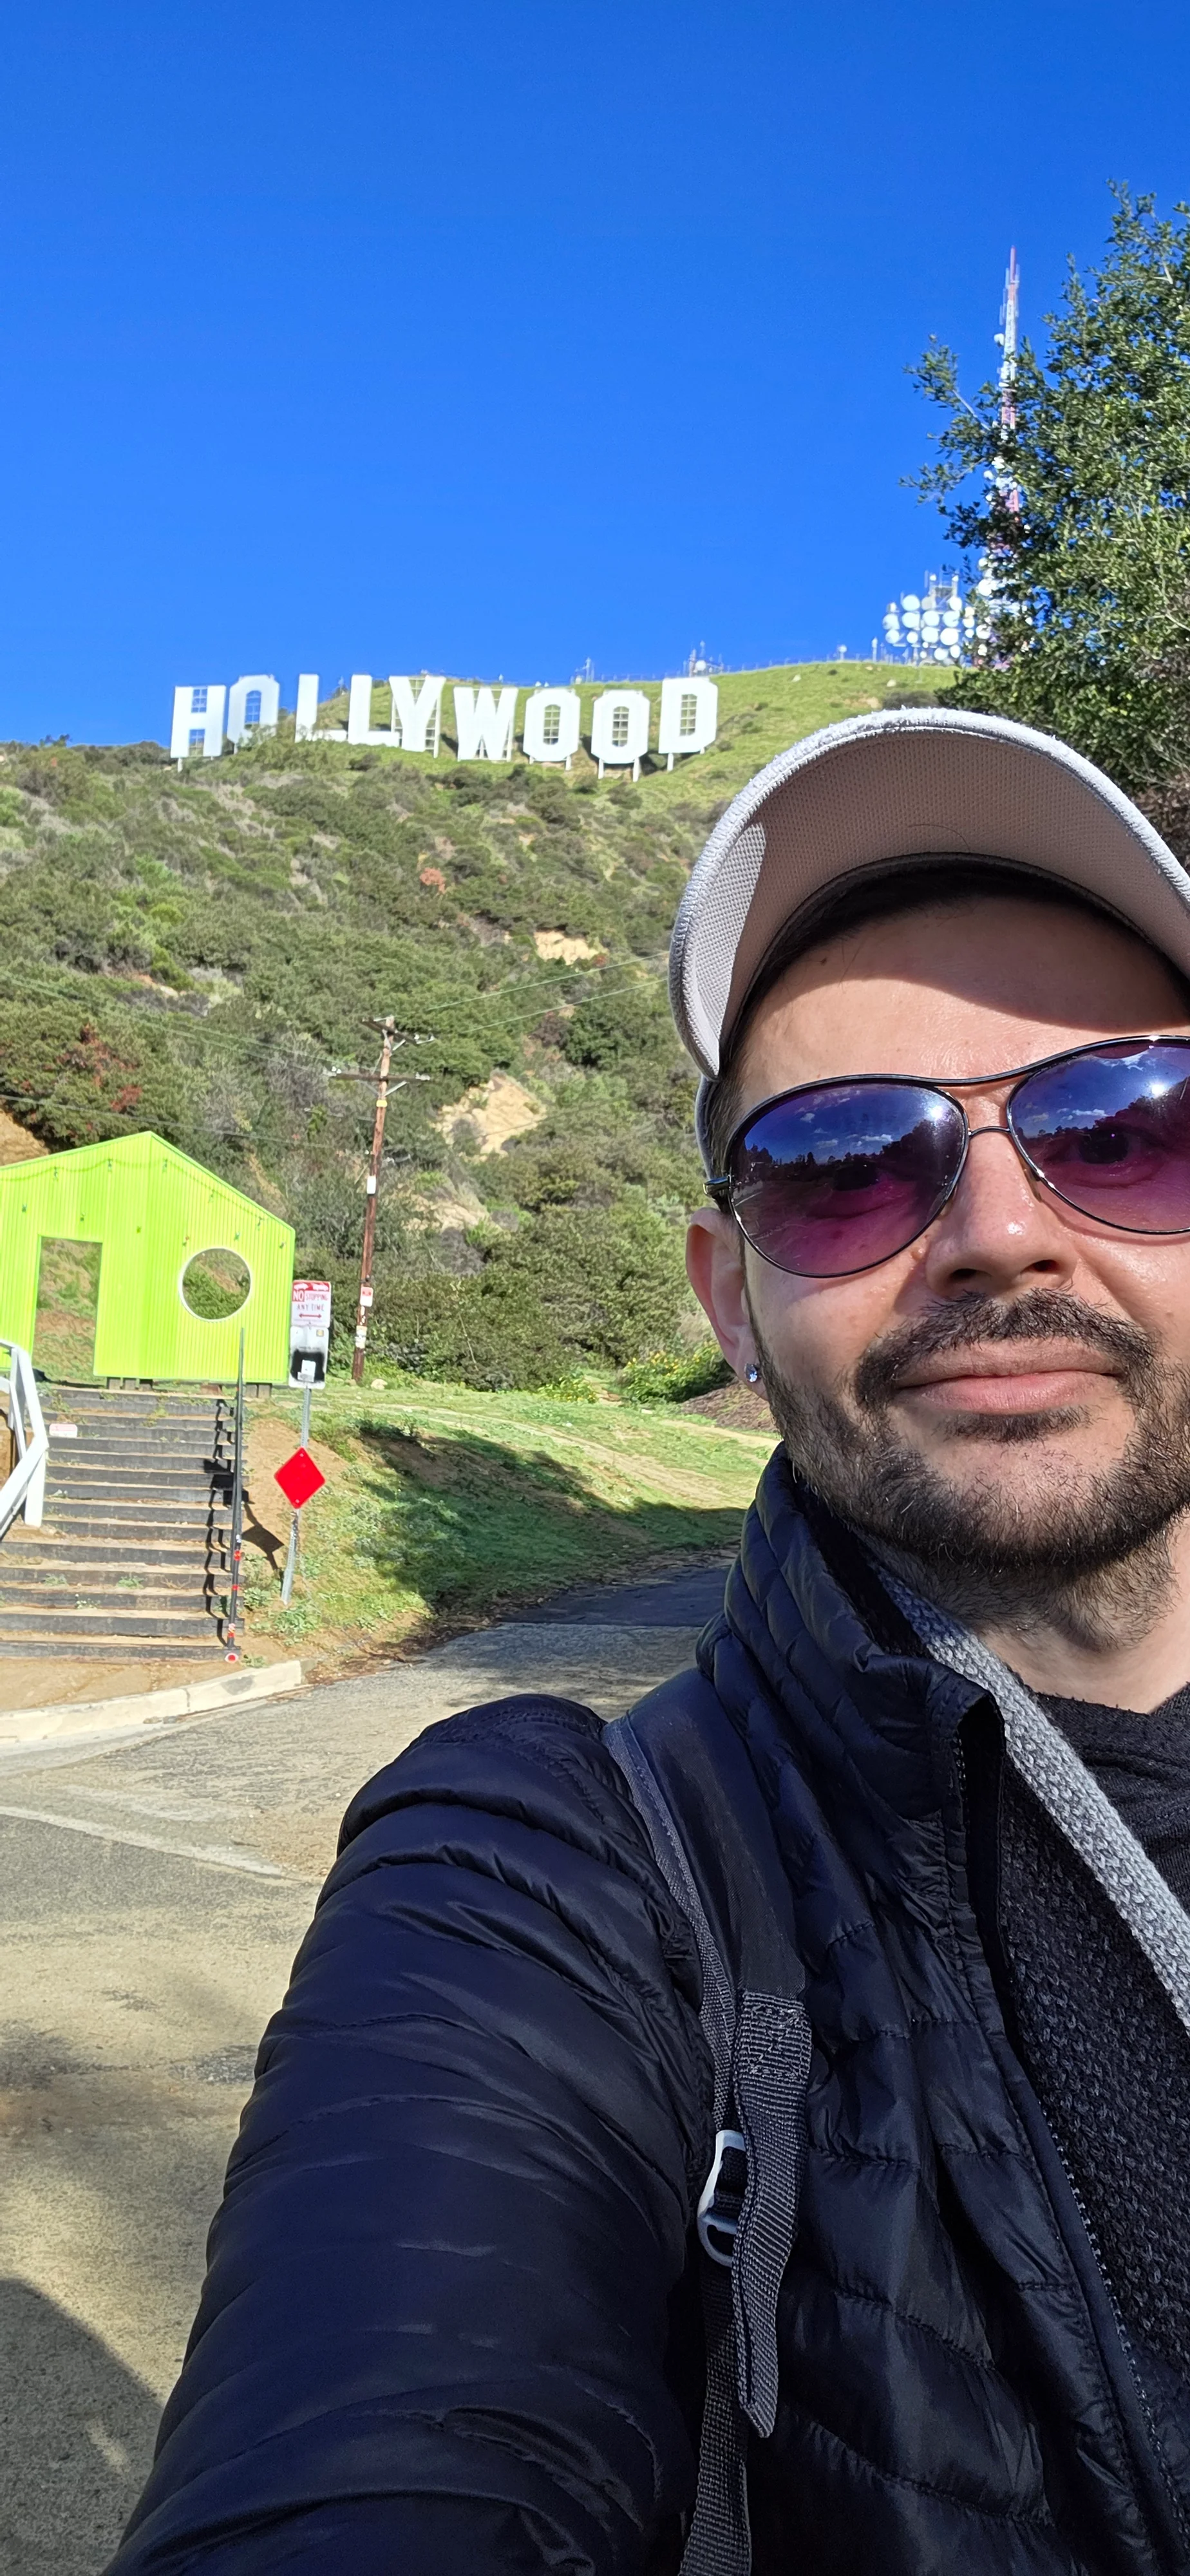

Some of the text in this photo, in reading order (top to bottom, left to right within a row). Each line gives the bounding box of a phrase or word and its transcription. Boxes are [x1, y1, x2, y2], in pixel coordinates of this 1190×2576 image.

[171, 674, 719, 764] HOLLYWOOD
[293, 1291, 304, 1301] NO
[311, 1303, 325, 1312] TIME
